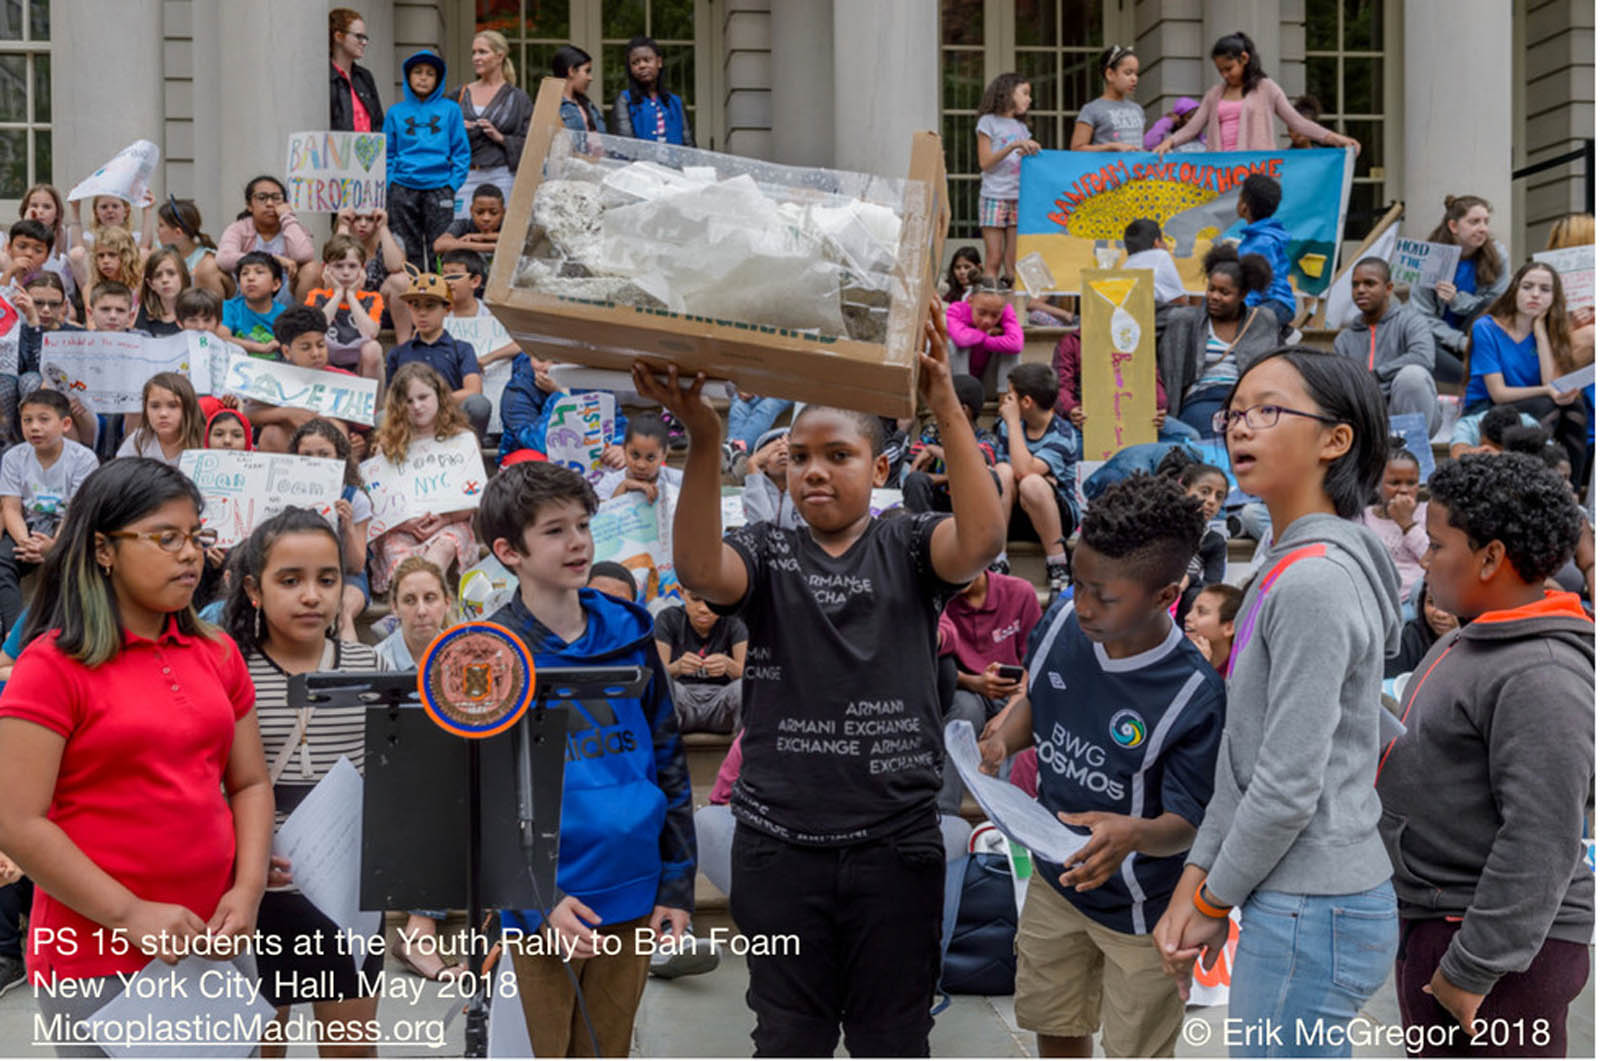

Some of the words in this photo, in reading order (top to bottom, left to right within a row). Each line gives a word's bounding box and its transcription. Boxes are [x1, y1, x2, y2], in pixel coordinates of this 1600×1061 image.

[288, 133, 352, 172] BAN
[1048, 181, 1086, 226] BAN
[1079, 160, 1130, 199] FOAM
[1132, 161, 1178, 182] SAVE
[1179, 162, 1214, 189] OUR
[1216, 158, 1283, 193] HOME
[232, 361, 326, 410] SAVE
[330, 387, 374, 421] THE
[414, 471, 451, 497] NYC
[846, 700, 904, 716] ARMANI
[778, 718, 836, 734] ARMANI
[844, 718, 920, 736] EXCHANGE
[776, 737, 861, 756] EXCHANGE
[870, 737, 922, 754] ARMANI
[1051, 721, 1106, 767] BWG
